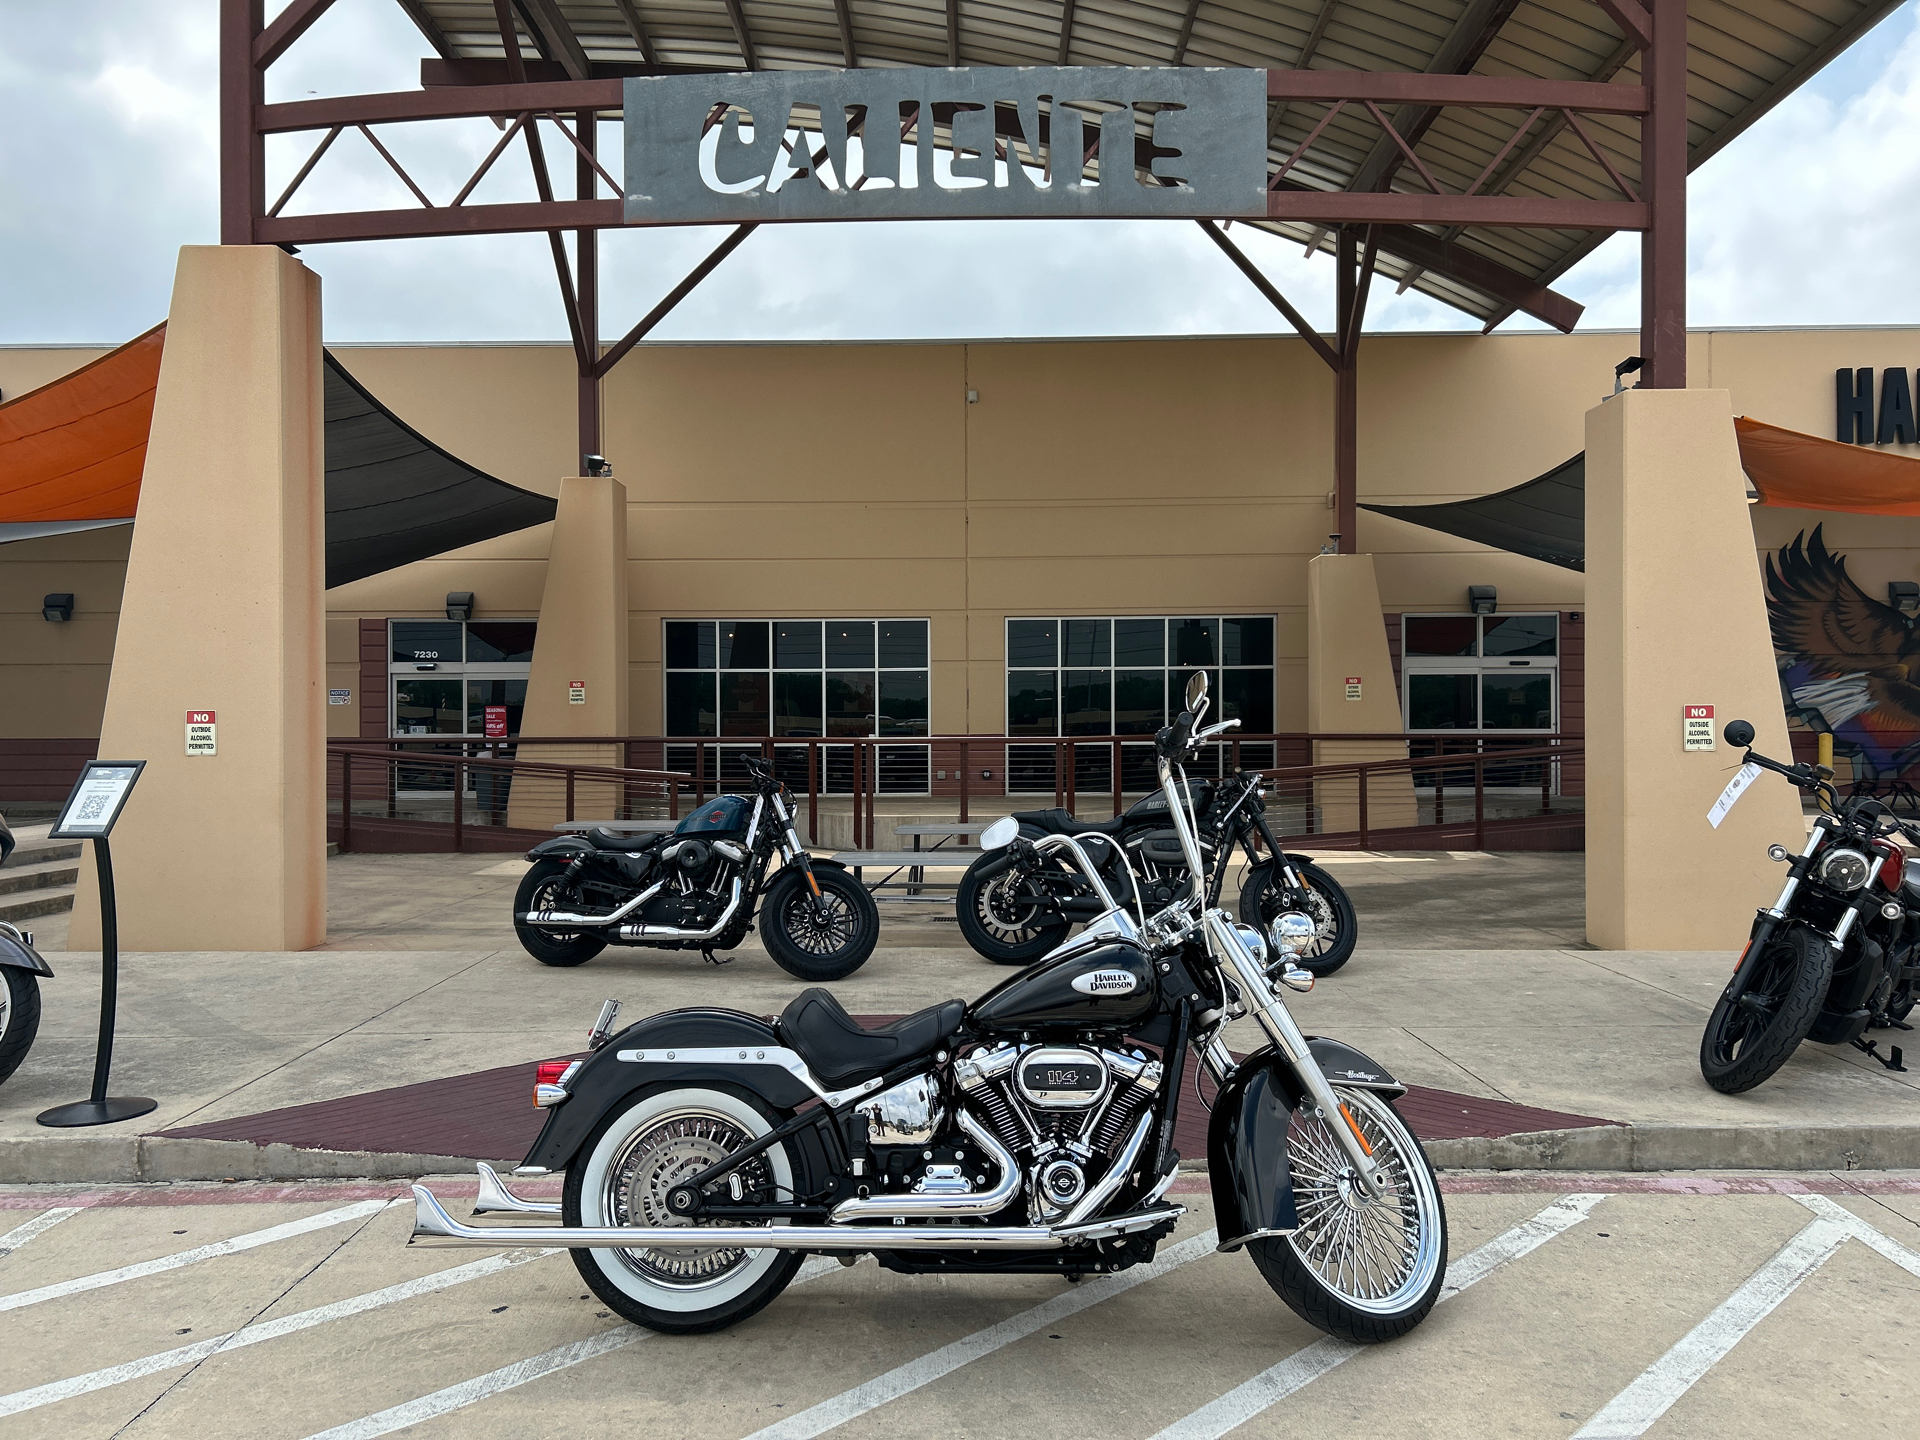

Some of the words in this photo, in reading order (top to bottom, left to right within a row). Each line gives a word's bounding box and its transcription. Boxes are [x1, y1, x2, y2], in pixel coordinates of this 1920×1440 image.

[699, 95, 1187, 194] CALIENTE
[1836, 367, 1920, 444] HA
[193, 713, 209, 722] NO
[1691, 708, 1707, 717] NO
[1090, 981, 1132, 991] DAVIDSON
[1047, 1070, 1079, 1082] 114
